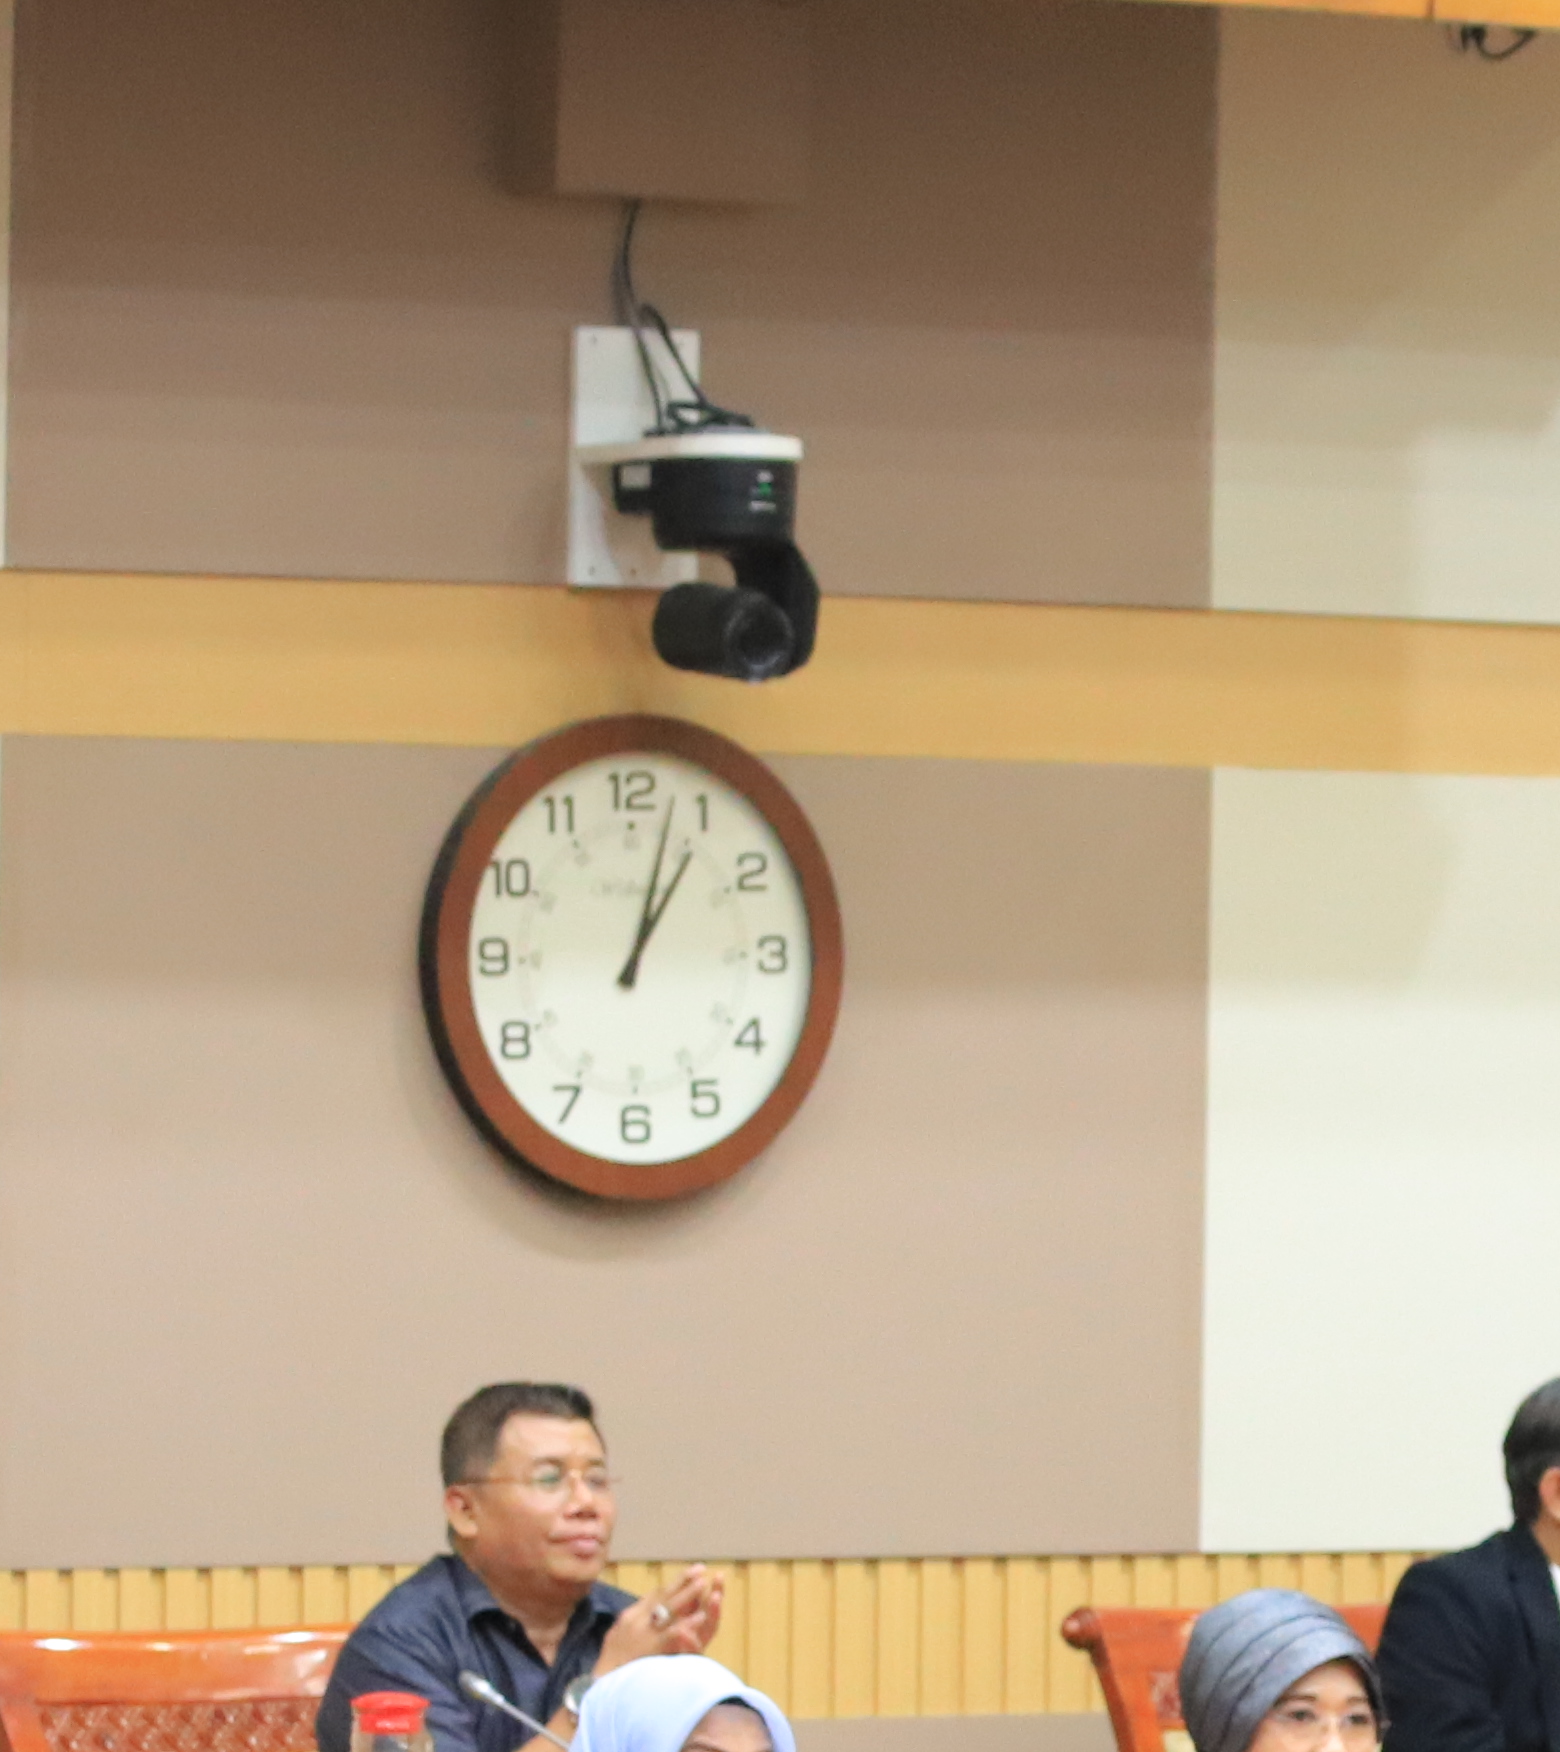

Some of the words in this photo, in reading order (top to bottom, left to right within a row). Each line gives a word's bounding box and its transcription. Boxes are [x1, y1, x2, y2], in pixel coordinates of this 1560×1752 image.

[608, 771, 655, 812] 12
[542, 795, 575, 834] 11
[695, 794, 709, 832] 1
[491, 859, 531, 898] 10
[736, 852, 768, 892] 2
[478, 937, 510, 977] 9
[757, 935, 788, 974] 3
[500, 1021, 531, 1060] 8
[733, 1018, 766, 1056] 4
[552, 1085, 583, 1124] 7
[690, 1079, 721, 1118] 5
[620, 1105, 653, 1144] 6
